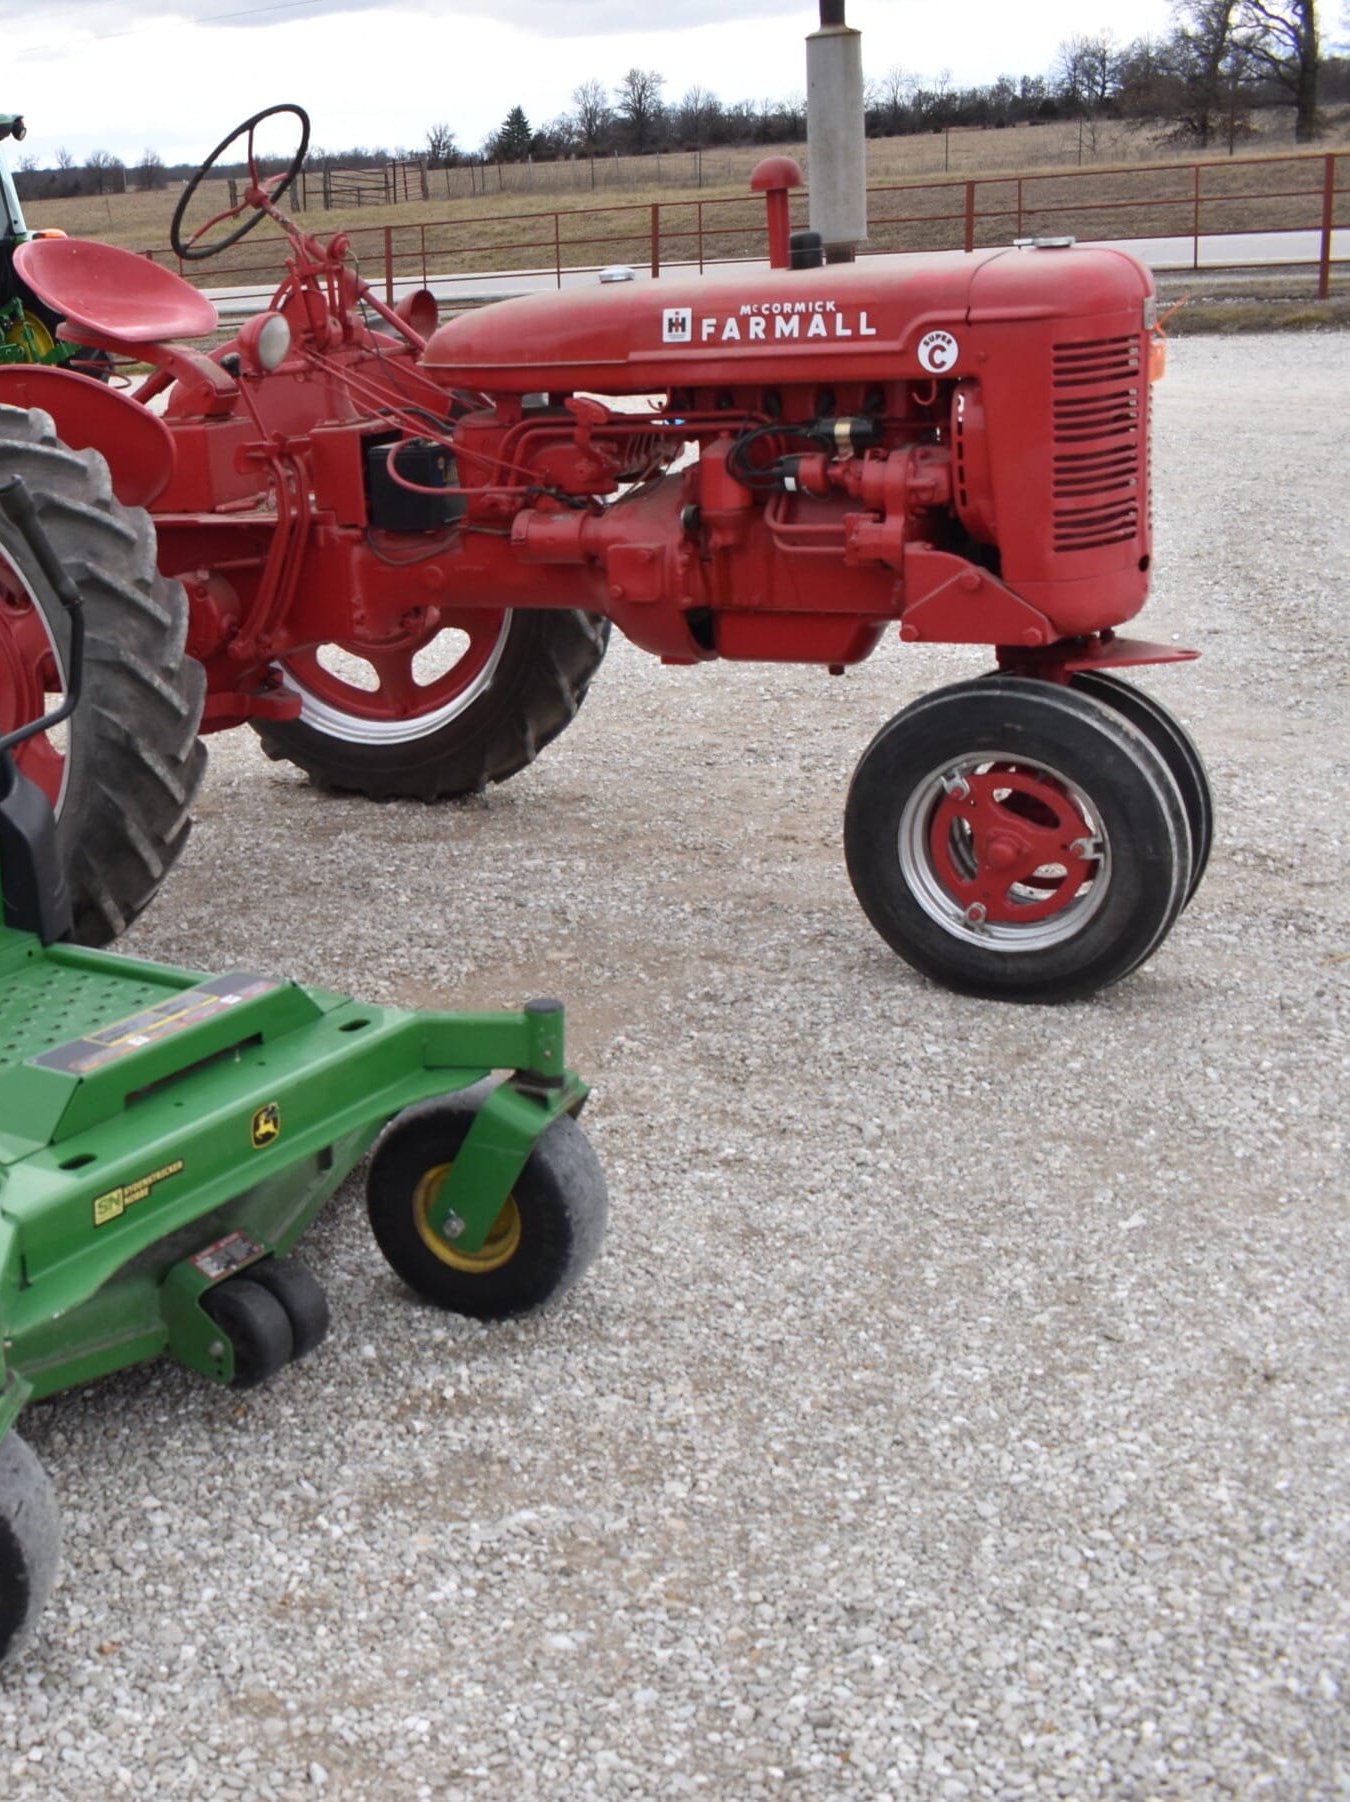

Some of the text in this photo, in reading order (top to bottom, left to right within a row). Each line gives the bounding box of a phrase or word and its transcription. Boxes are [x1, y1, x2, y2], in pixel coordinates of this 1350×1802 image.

[702, 311, 877, 341] FARMALL
[923, 333, 952, 347] SUPER
[928, 344, 947, 369] C
[97, 1191, 121, 1215] SN
